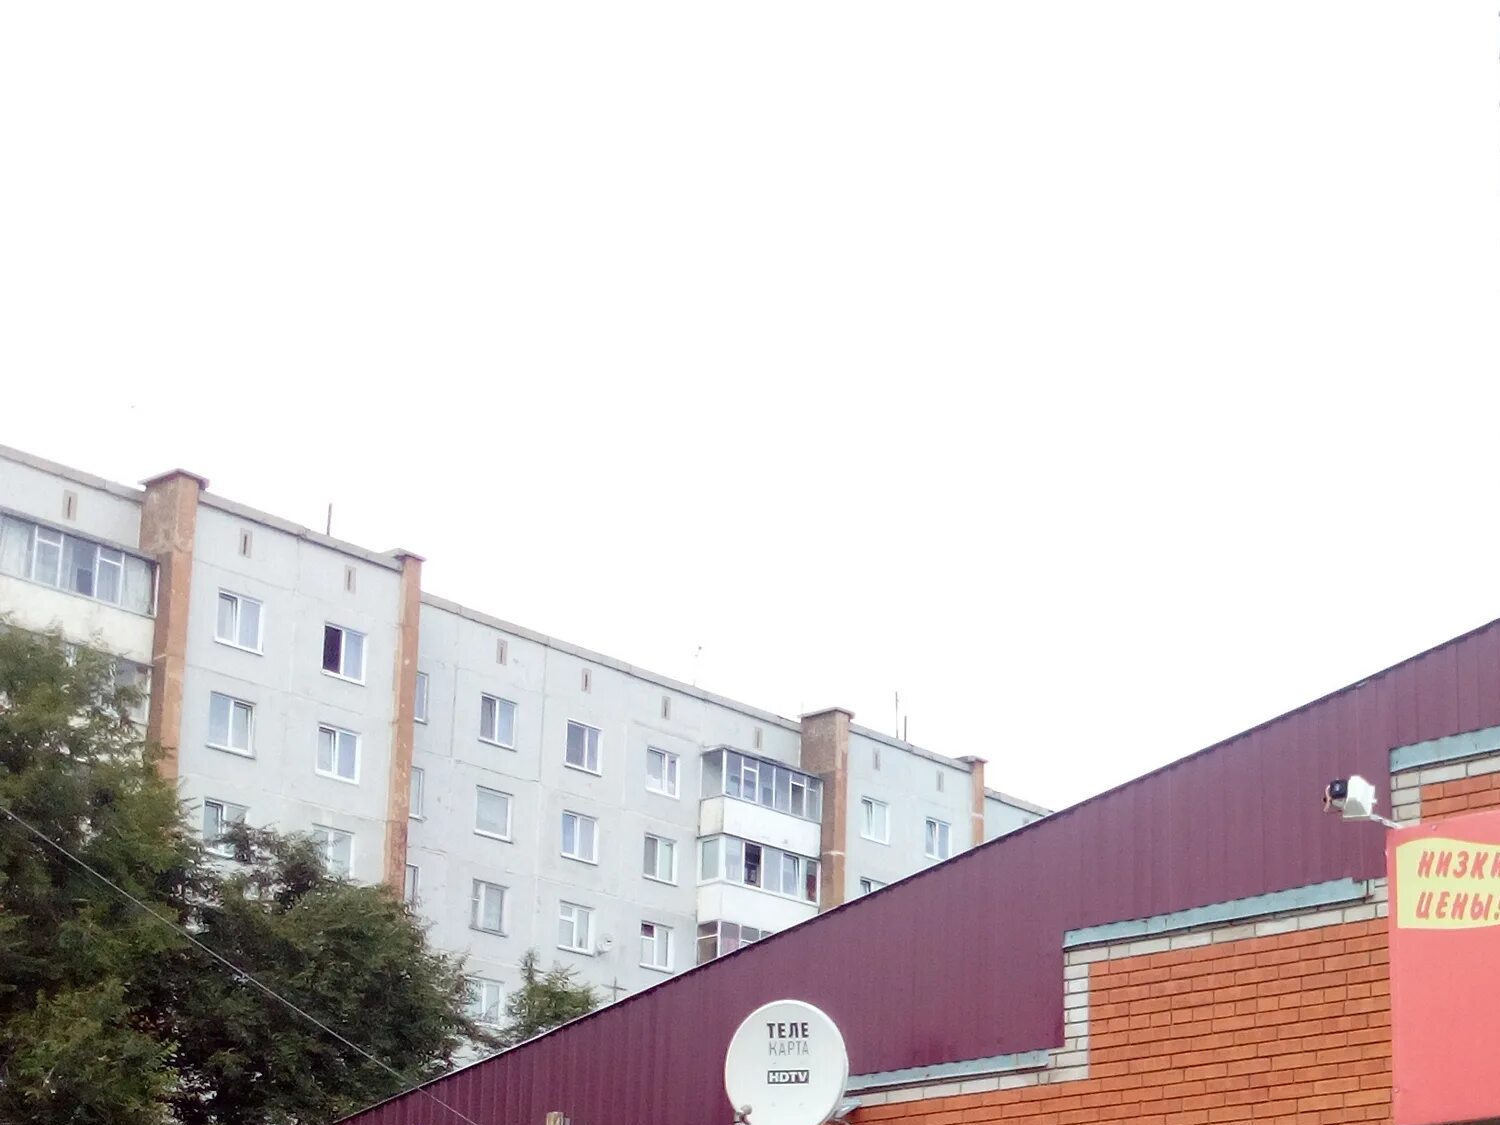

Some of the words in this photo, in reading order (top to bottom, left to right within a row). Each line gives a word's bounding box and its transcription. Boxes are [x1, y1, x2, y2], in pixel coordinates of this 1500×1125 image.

[767, 1022, 809, 1039] ТЕЛЕ
[768, 1040, 810, 1056] КАРТА
[768, 1071, 809, 1084] HDTV
